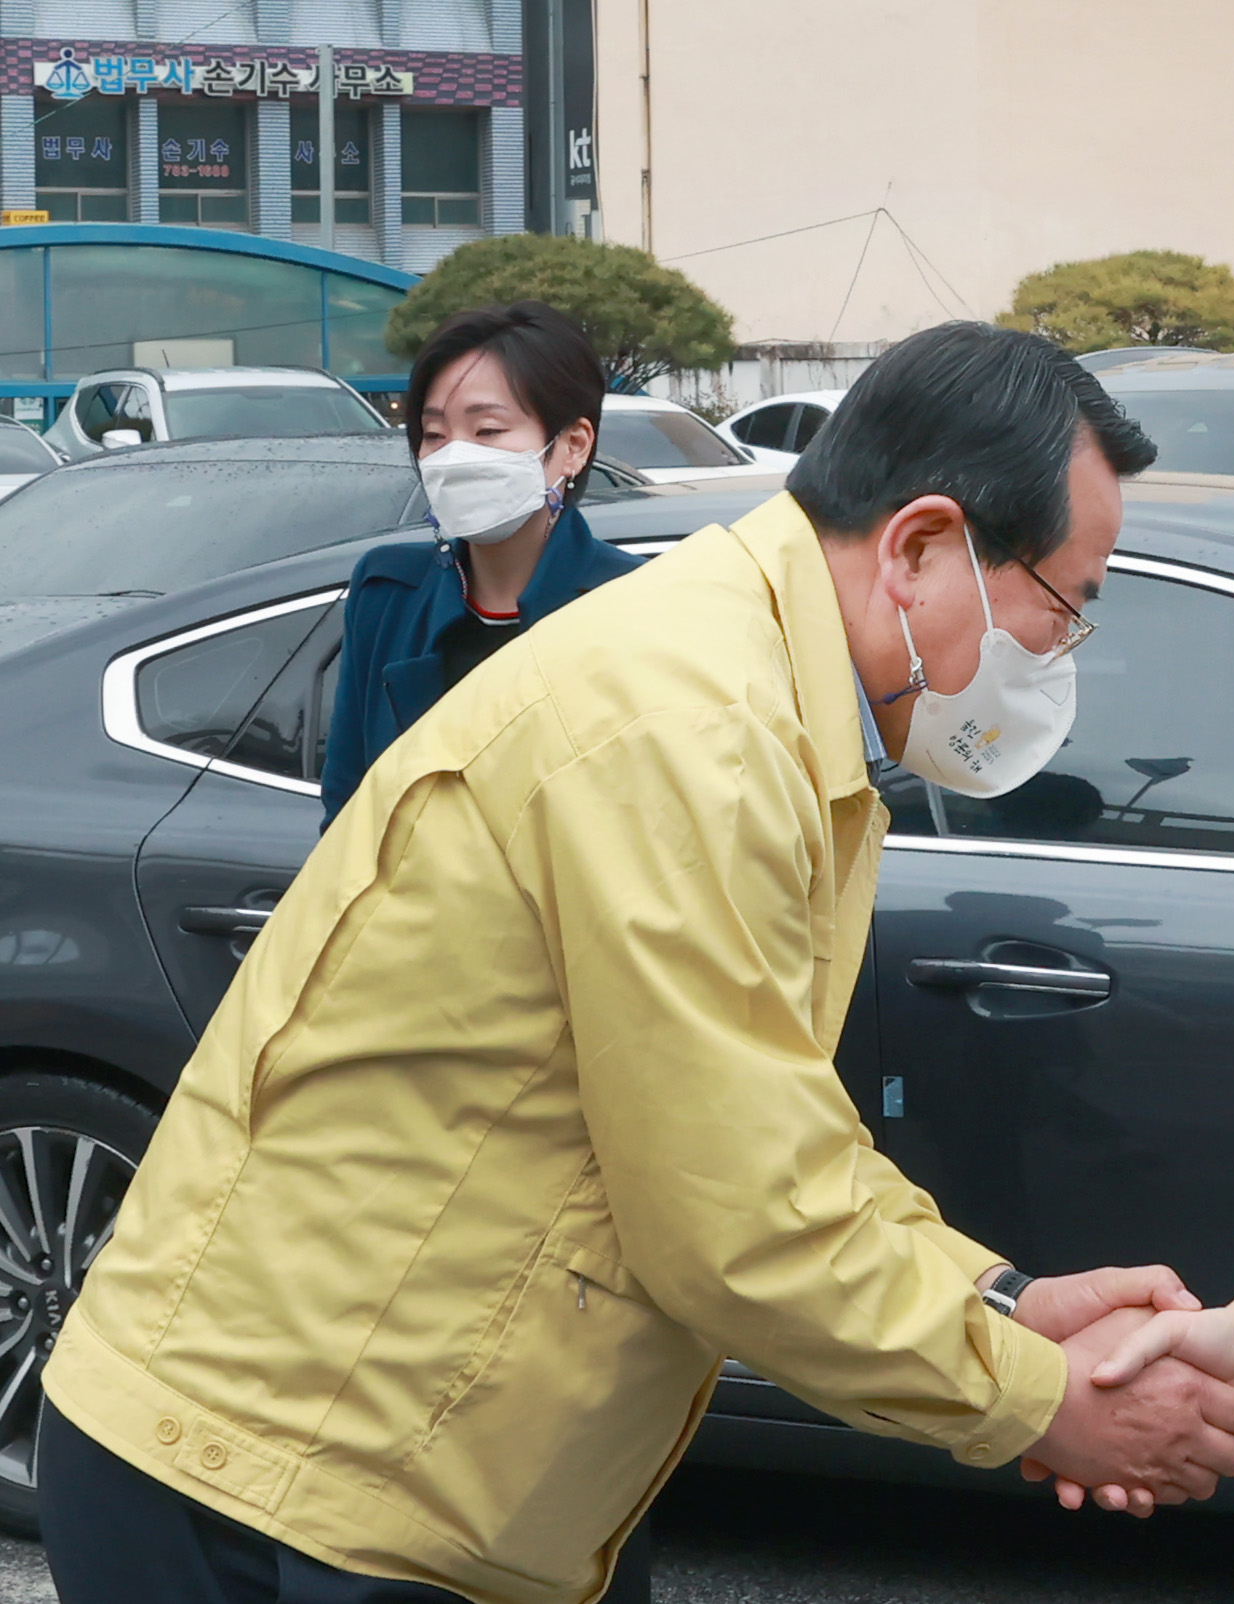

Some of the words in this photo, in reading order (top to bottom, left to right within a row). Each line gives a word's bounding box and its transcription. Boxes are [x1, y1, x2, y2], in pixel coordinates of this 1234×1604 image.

[92, 56, 195, 95] 법무사
[203, 58, 301, 97] 손기수
[42, 136, 112, 160] 법무사
[162, 138, 230, 162] 손기수
[294, 140, 360, 164] 사소
[569, 128, 591, 169] kt
[45, 1290, 62, 1325] KIA
